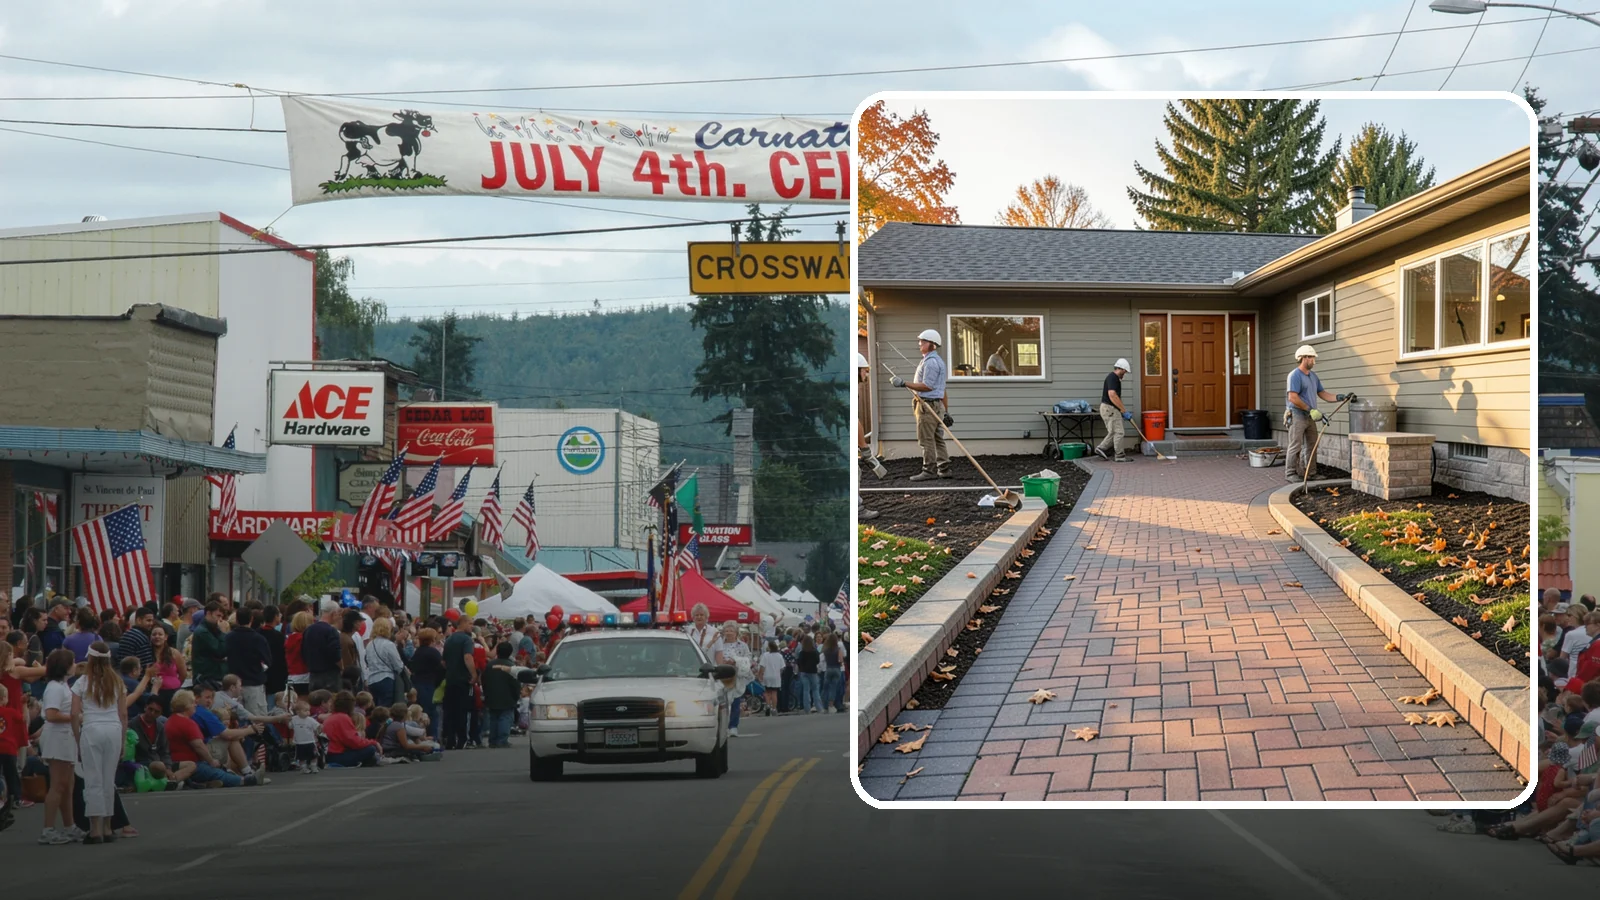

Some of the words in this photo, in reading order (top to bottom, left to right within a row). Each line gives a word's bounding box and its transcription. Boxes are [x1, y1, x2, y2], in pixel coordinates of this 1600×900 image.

[481, 141, 604, 192] JULY
[632, 150, 746, 197] 4th.
[697, 254, 850, 280] CROSSWA
[282, 380, 373, 420] ACE
[405, 409, 452, 421] CEDAR
[283, 421, 371, 436] Hardware
[416, 428, 477, 447] Coca-Cola
[95, 485, 124, 495] Vincent
[126, 486, 136, 495] de
[137, 486, 155, 495] Paul
[212, 516, 330, 535] HARDARE
[699, 535, 730, 543] GLASS
